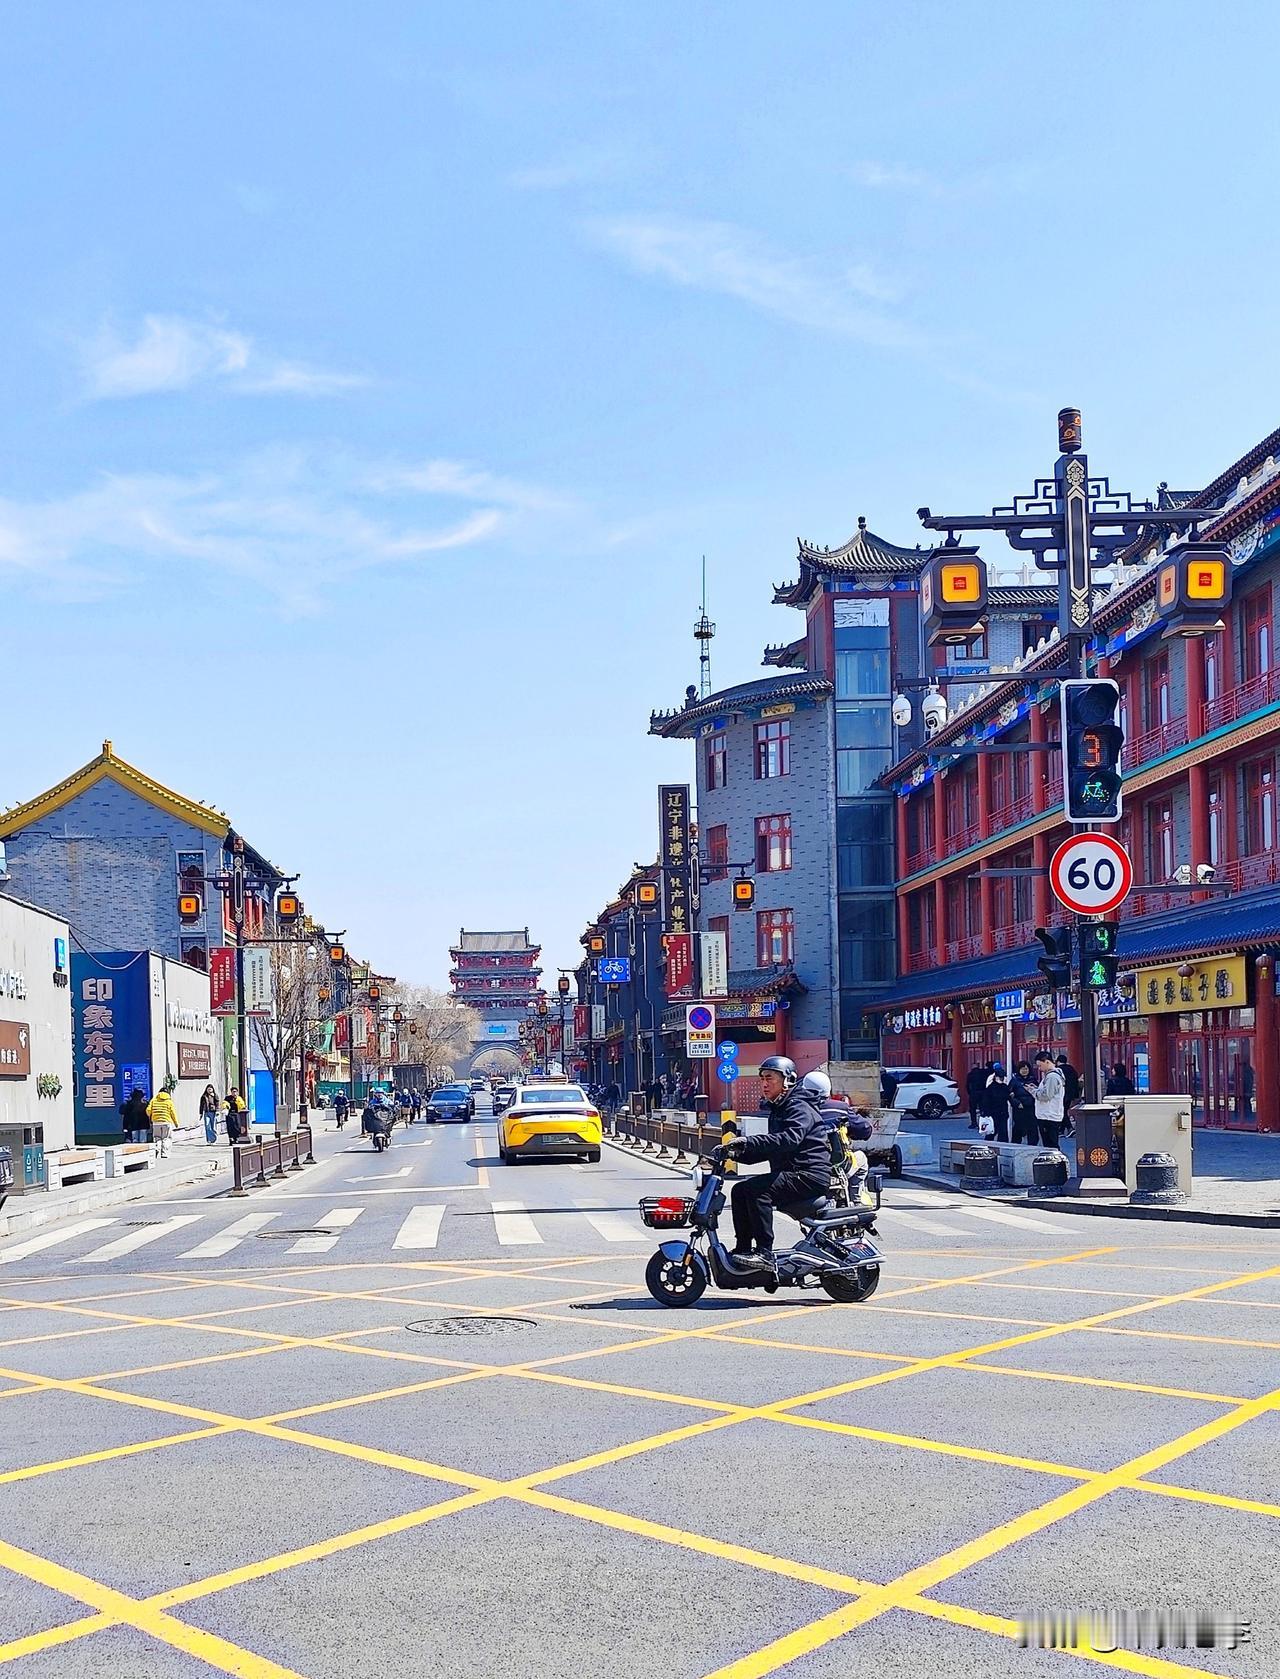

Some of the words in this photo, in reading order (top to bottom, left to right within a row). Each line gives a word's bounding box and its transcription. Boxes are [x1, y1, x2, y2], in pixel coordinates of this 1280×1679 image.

[1083, 734, 1100, 767] 3
[1067, 857, 1116, 891] 60
[1095, 926, 1109, 951] 9
[82, 978, 116, 1107] 印象东华里
